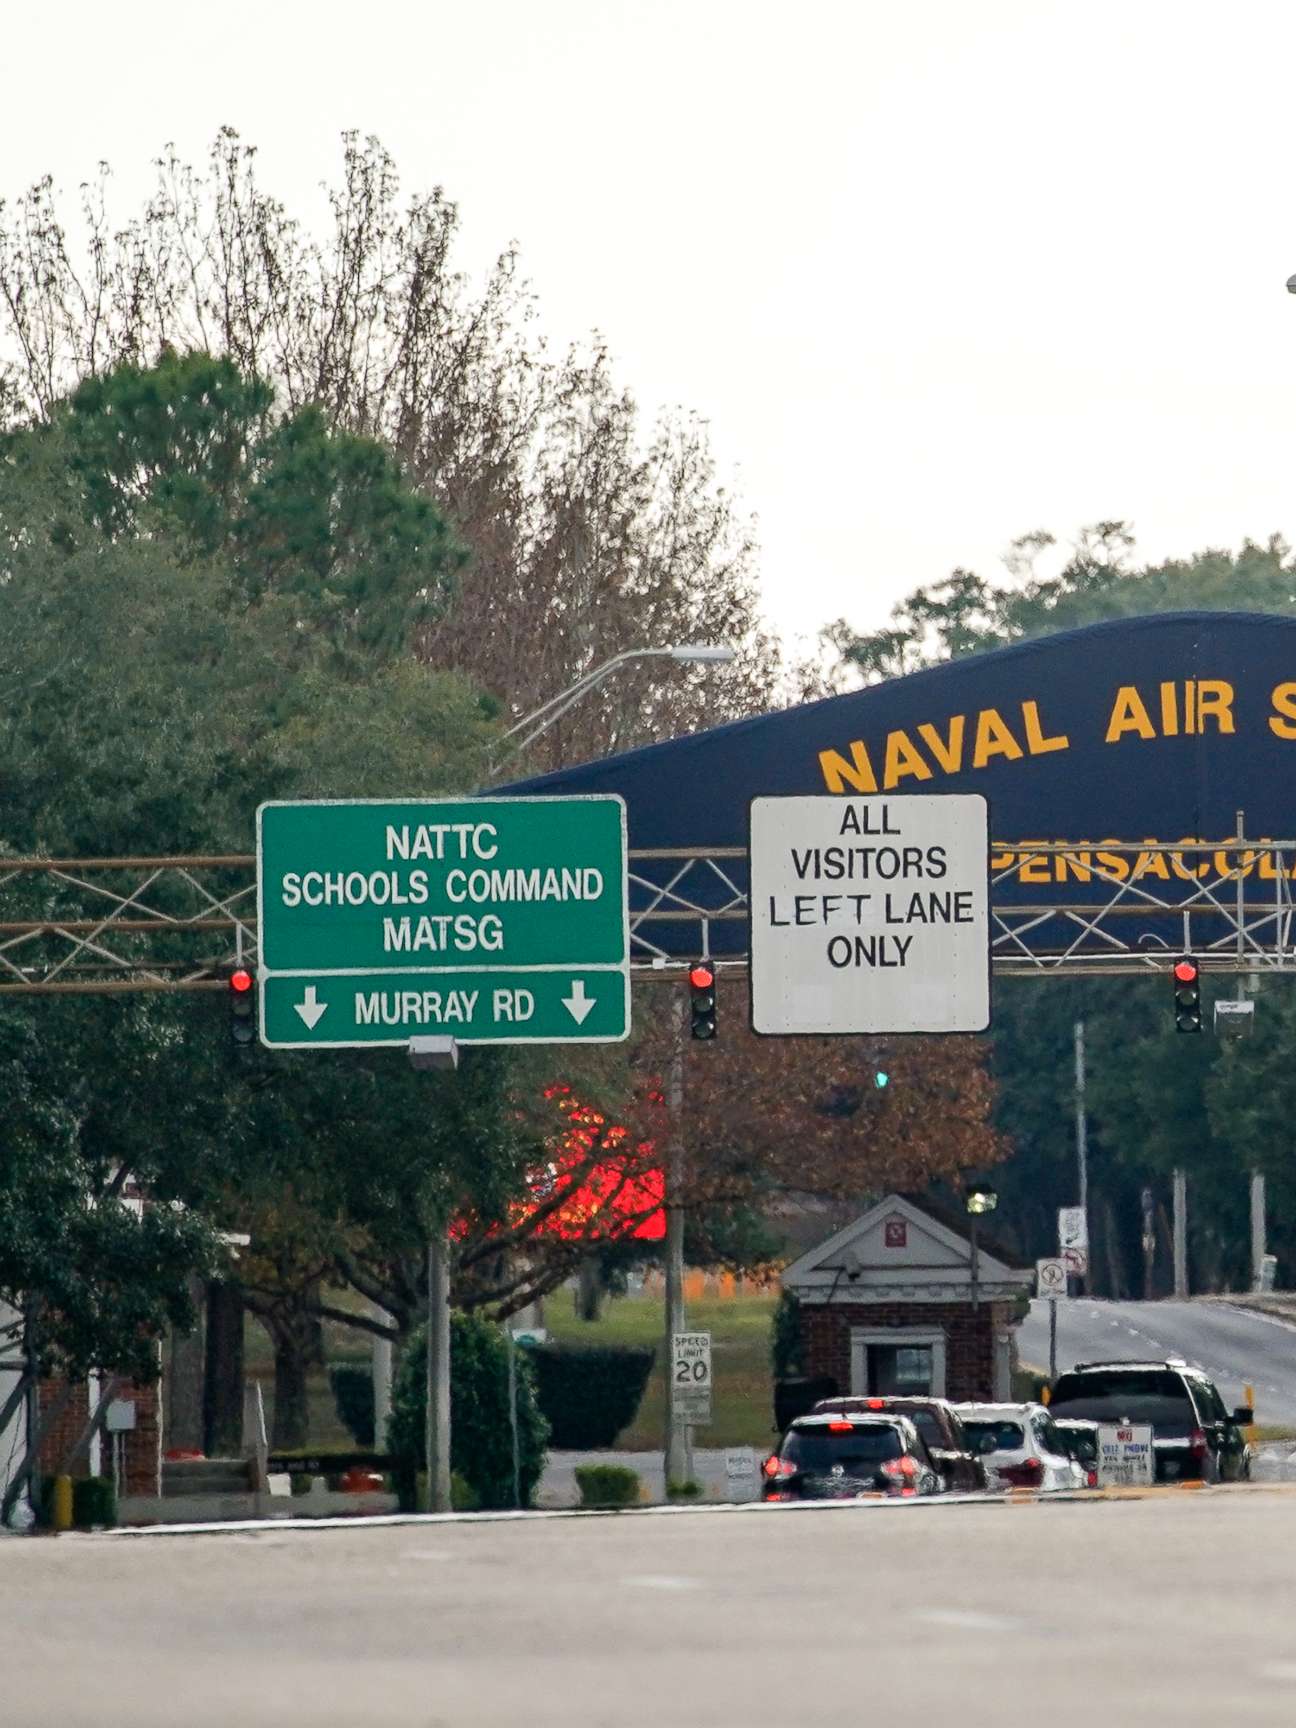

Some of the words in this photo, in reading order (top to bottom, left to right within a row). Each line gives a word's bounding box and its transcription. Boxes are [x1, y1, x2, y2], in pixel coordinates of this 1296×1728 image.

[819, 701, 1069, 793] NAVAL
[1106, 680, 1235, 742] AIR
[839, 804, 901, 835] ALL
[386, 823, 498, 860] NATTC
[791, 846, 948, 880] VISITORS
[282, 869, 429, 907] SCHOOLS
[446, 867, 604, 903] COMMAND
[769, 894, 872, 927] LEFT
[885, 891, 974, 924] LANE
[383, 914, 504, 951] MATSG
[827, 935, 914, 969] ONLY
[354, 990, 479, 1025] MURRAY
[493, 989, 535, 1022] RD
[676, 1360, 707, 1382] 20
